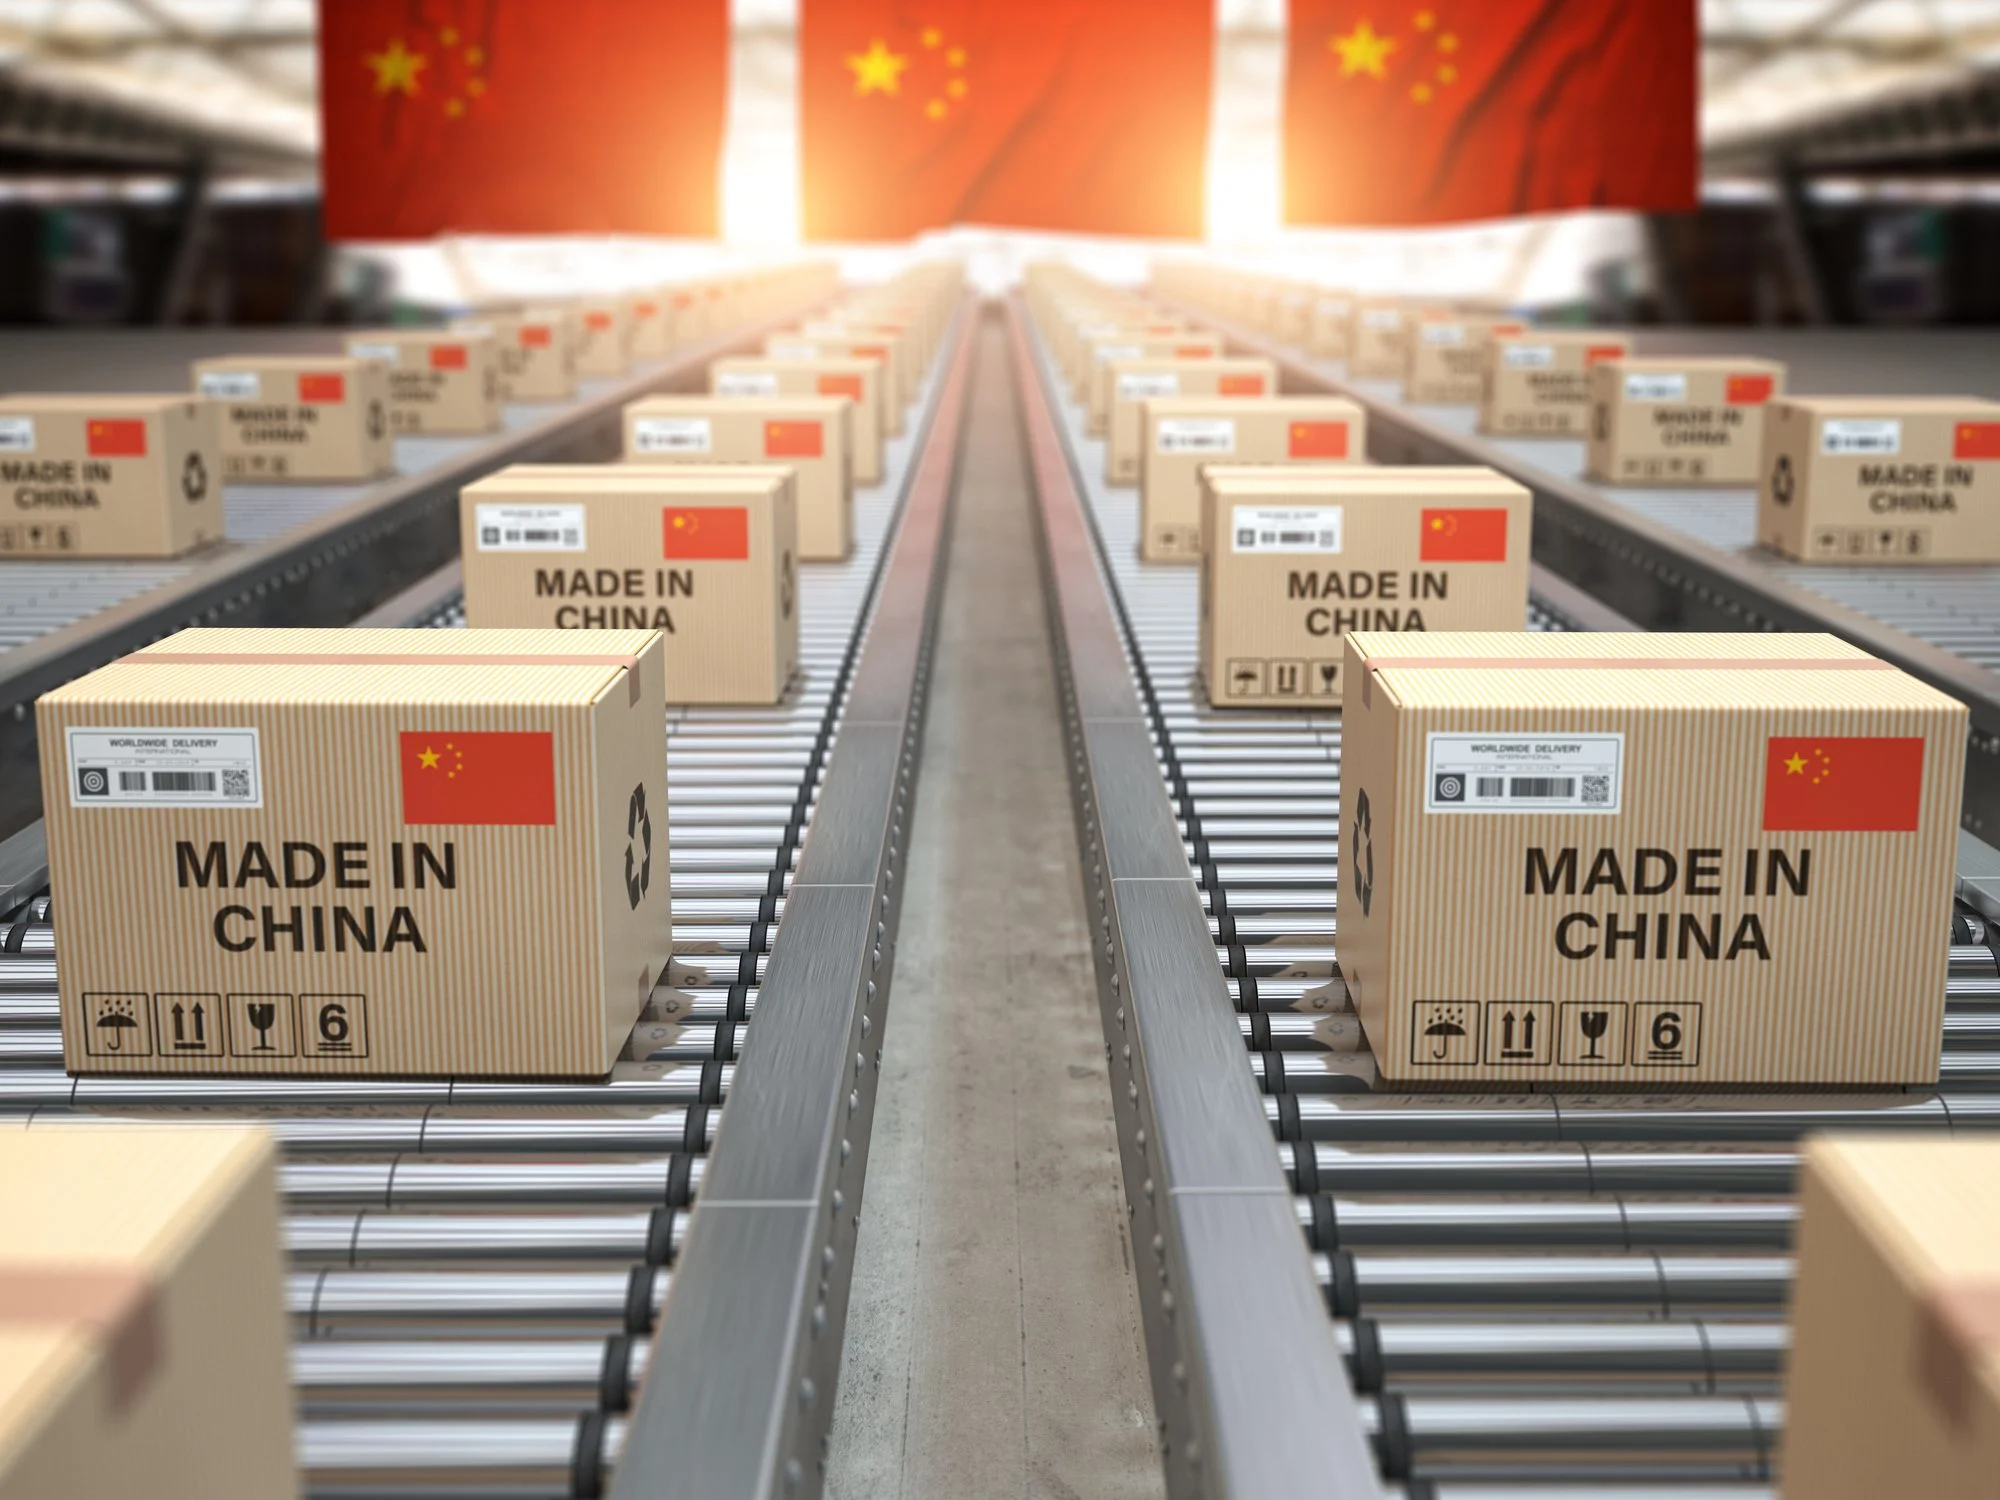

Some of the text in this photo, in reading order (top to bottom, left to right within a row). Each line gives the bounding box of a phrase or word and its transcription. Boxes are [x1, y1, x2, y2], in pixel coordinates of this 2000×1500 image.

[1, 461, 111, 483] MADE IN
[1858, 465, 1974, 487] MADE IN
[14, 487, 101, 510] CHINA
[1869, 491, 1956, 514] CHINA
[535, 569, 694, 598] MADE IN
[1288, 571, 1448, 601] MADE IN
[555, 605, 676, 634] CHINA
[1305, 607, 1426, 636] CHINA
[109, 738, 218, 748] WORLDWIDE DELIVERY
[1471, 744, 1582, 753] WORLDWIDE DELIVERY
[175, 841, 456, 890] MADE IN
[1525, 847, 1811, 896] MADE IN
[213, 904, 427, 953] CHINA
[1555, 911, 1771, 960] CHINA
[318, 1002, 349, 1042] 6
[1651, 1011, 1683, 1051] 6
